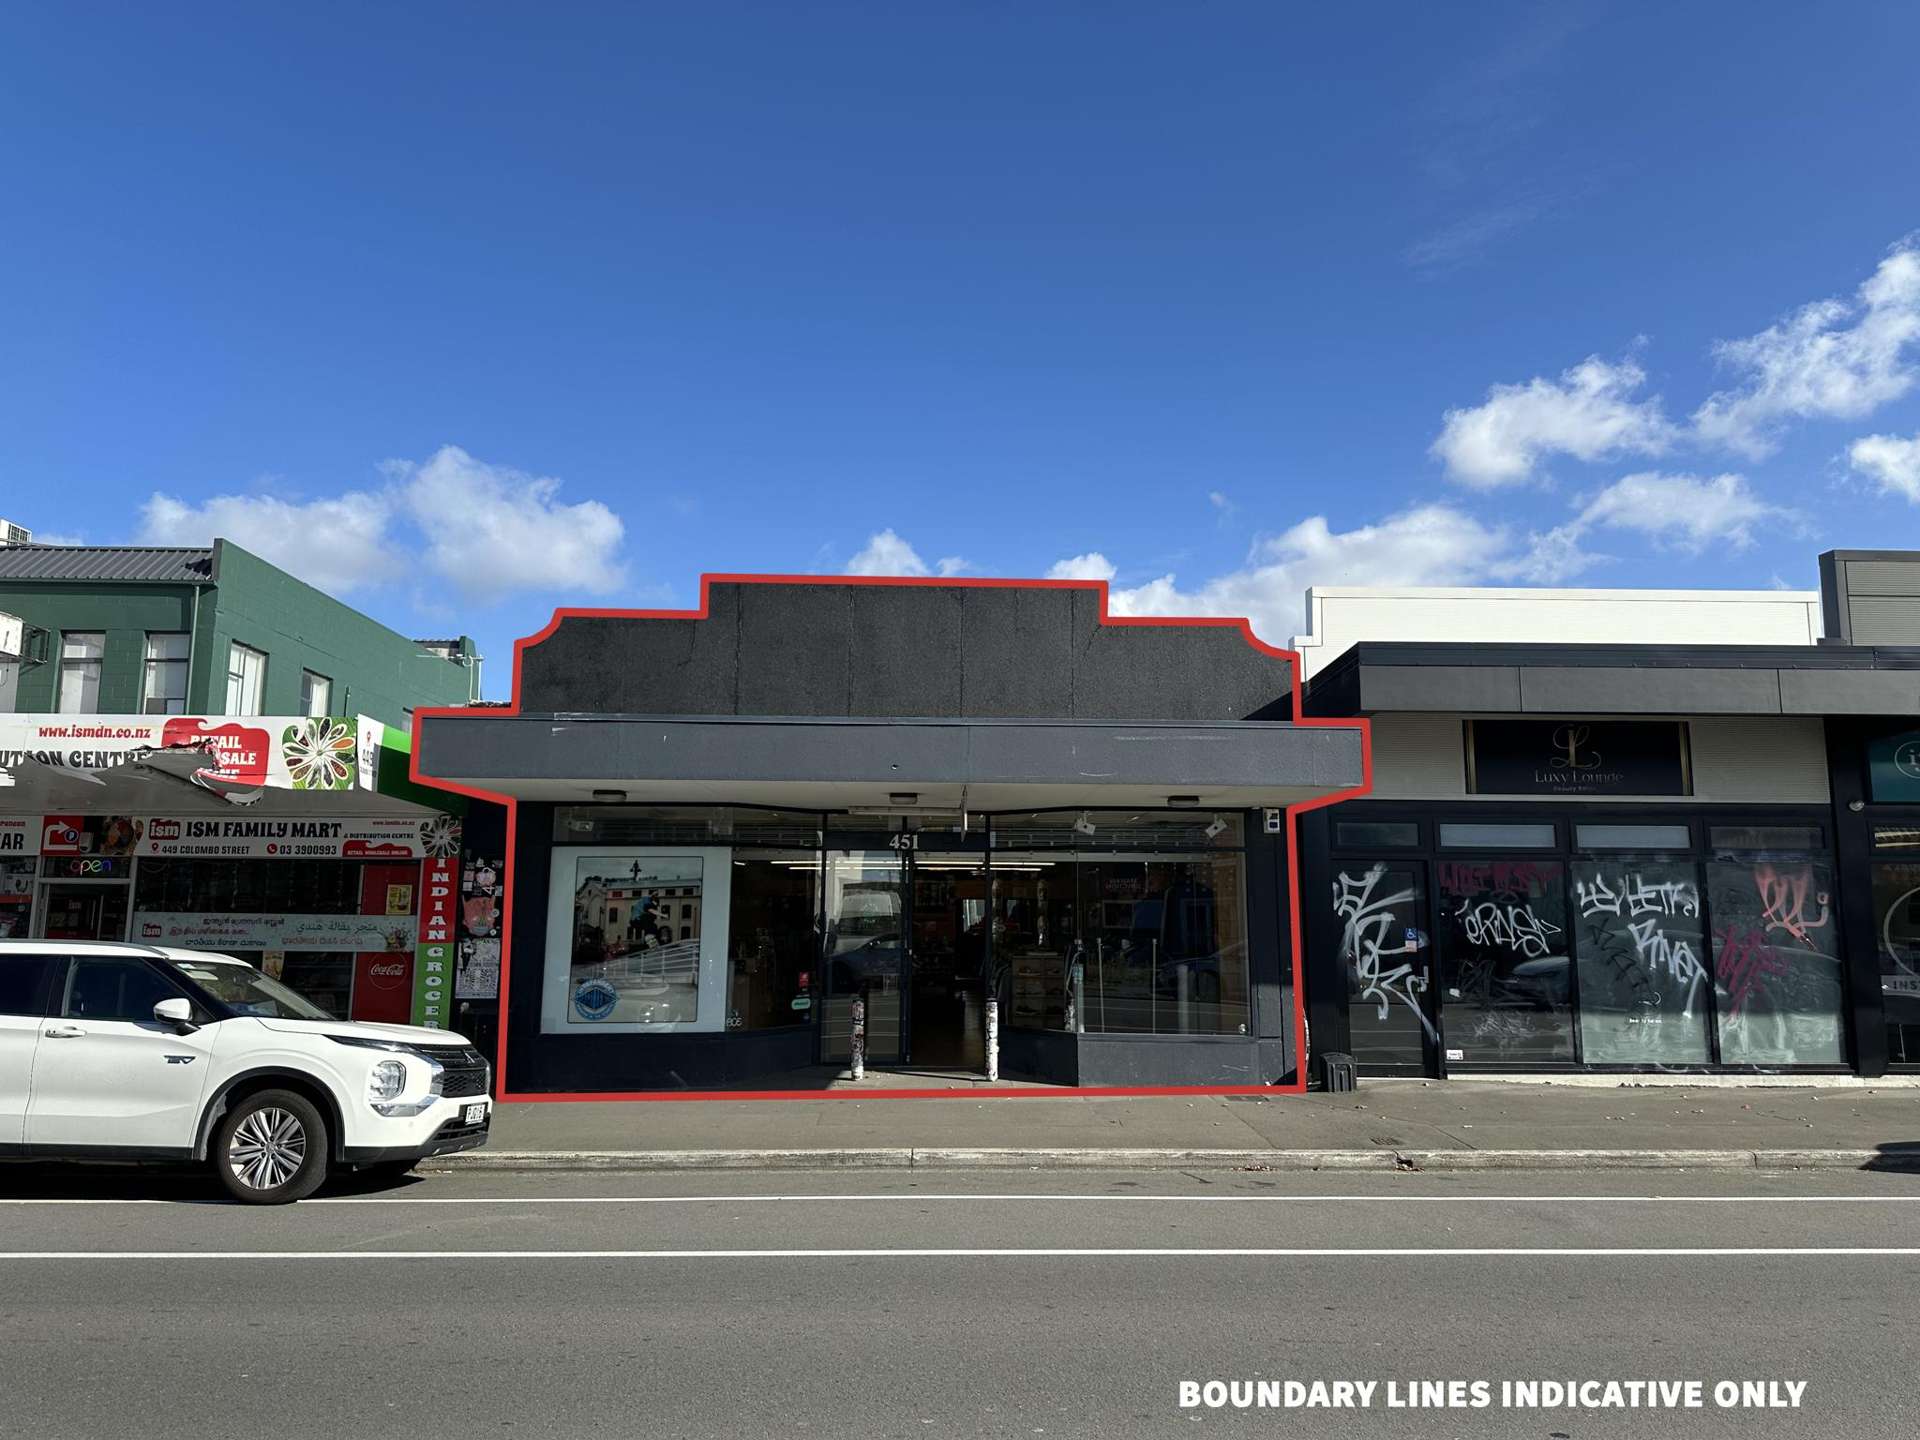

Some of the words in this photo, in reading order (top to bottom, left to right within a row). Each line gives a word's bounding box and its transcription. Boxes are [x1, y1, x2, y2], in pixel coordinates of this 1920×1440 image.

[38, 724, 152, 739] www.ismdn.co.nz
[0, 750, 65, 767] UTON
[1535, 769, 1568, 785] Luxy
[150, 822, 179, 838] ism
[185, 821, 220, 838] ISM
[223, 821, 288, 838] FAMILY
[290, 822, 342, 838] MART
[0, 832, 24, 850] AR
[889, 833, 919, 850] 451
[161, 845, 178, 854] 449
[179, 845, 220, 854] COLOMBO
[221, 845, 251, 855] STREET
[279, 844, 292, 855] 03
[294, 844, 337, 855] 3900993
[70, 860, 112, 876] open
[427, 858, 450, 941] INDIAN
[1892, 980, 1920, 990] INS
